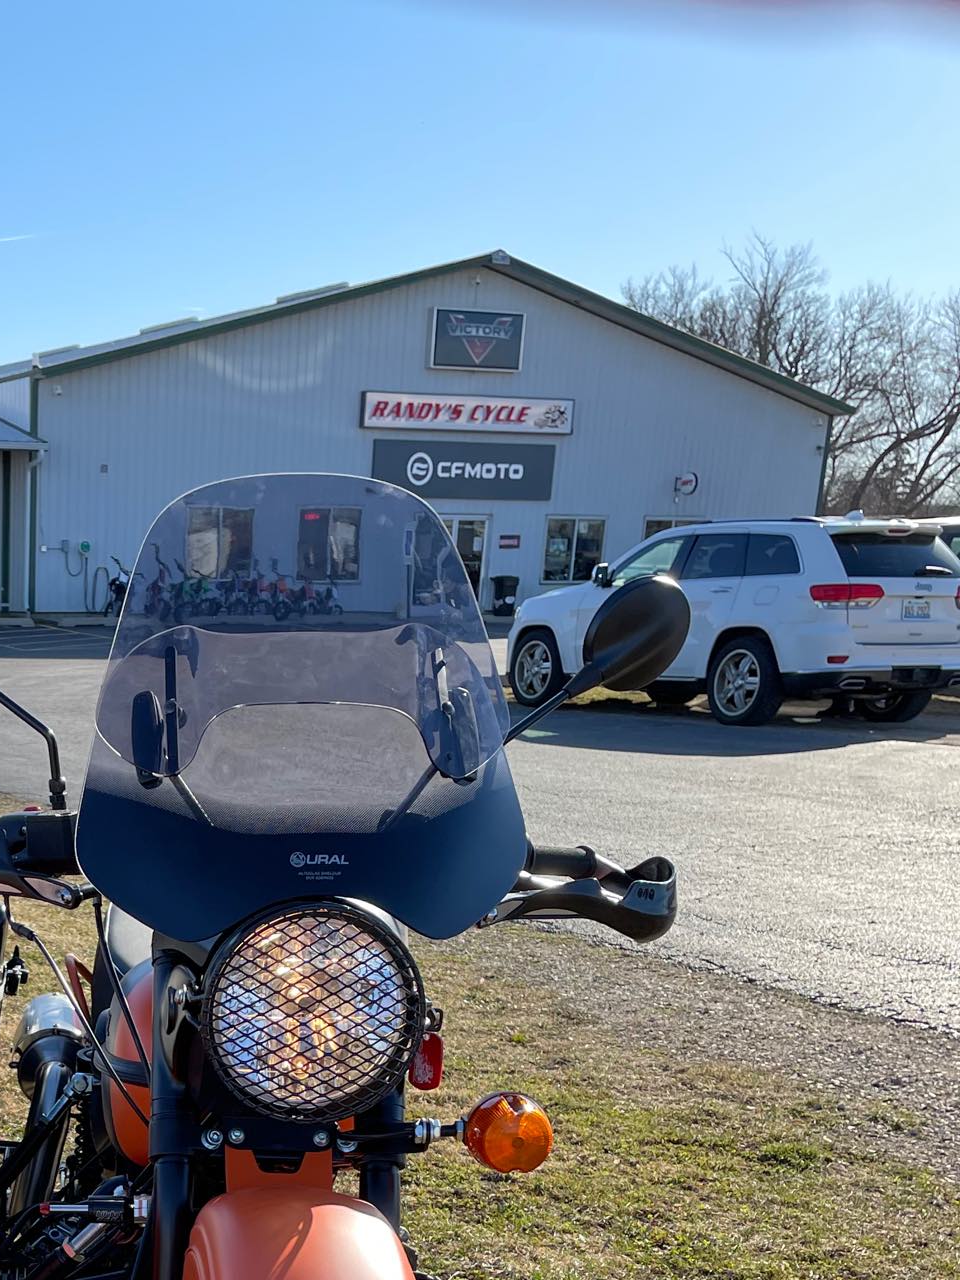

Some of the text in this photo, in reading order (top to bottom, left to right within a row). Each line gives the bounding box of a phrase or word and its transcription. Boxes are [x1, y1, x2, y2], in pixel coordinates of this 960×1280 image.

[447, 323, 513, 338] VICTORY
[370, 400, 530, 423] RANDY'S CYCLE
[437, 462, 523, 479] CFMOTO
[306, 854, 349, 865] URAL
